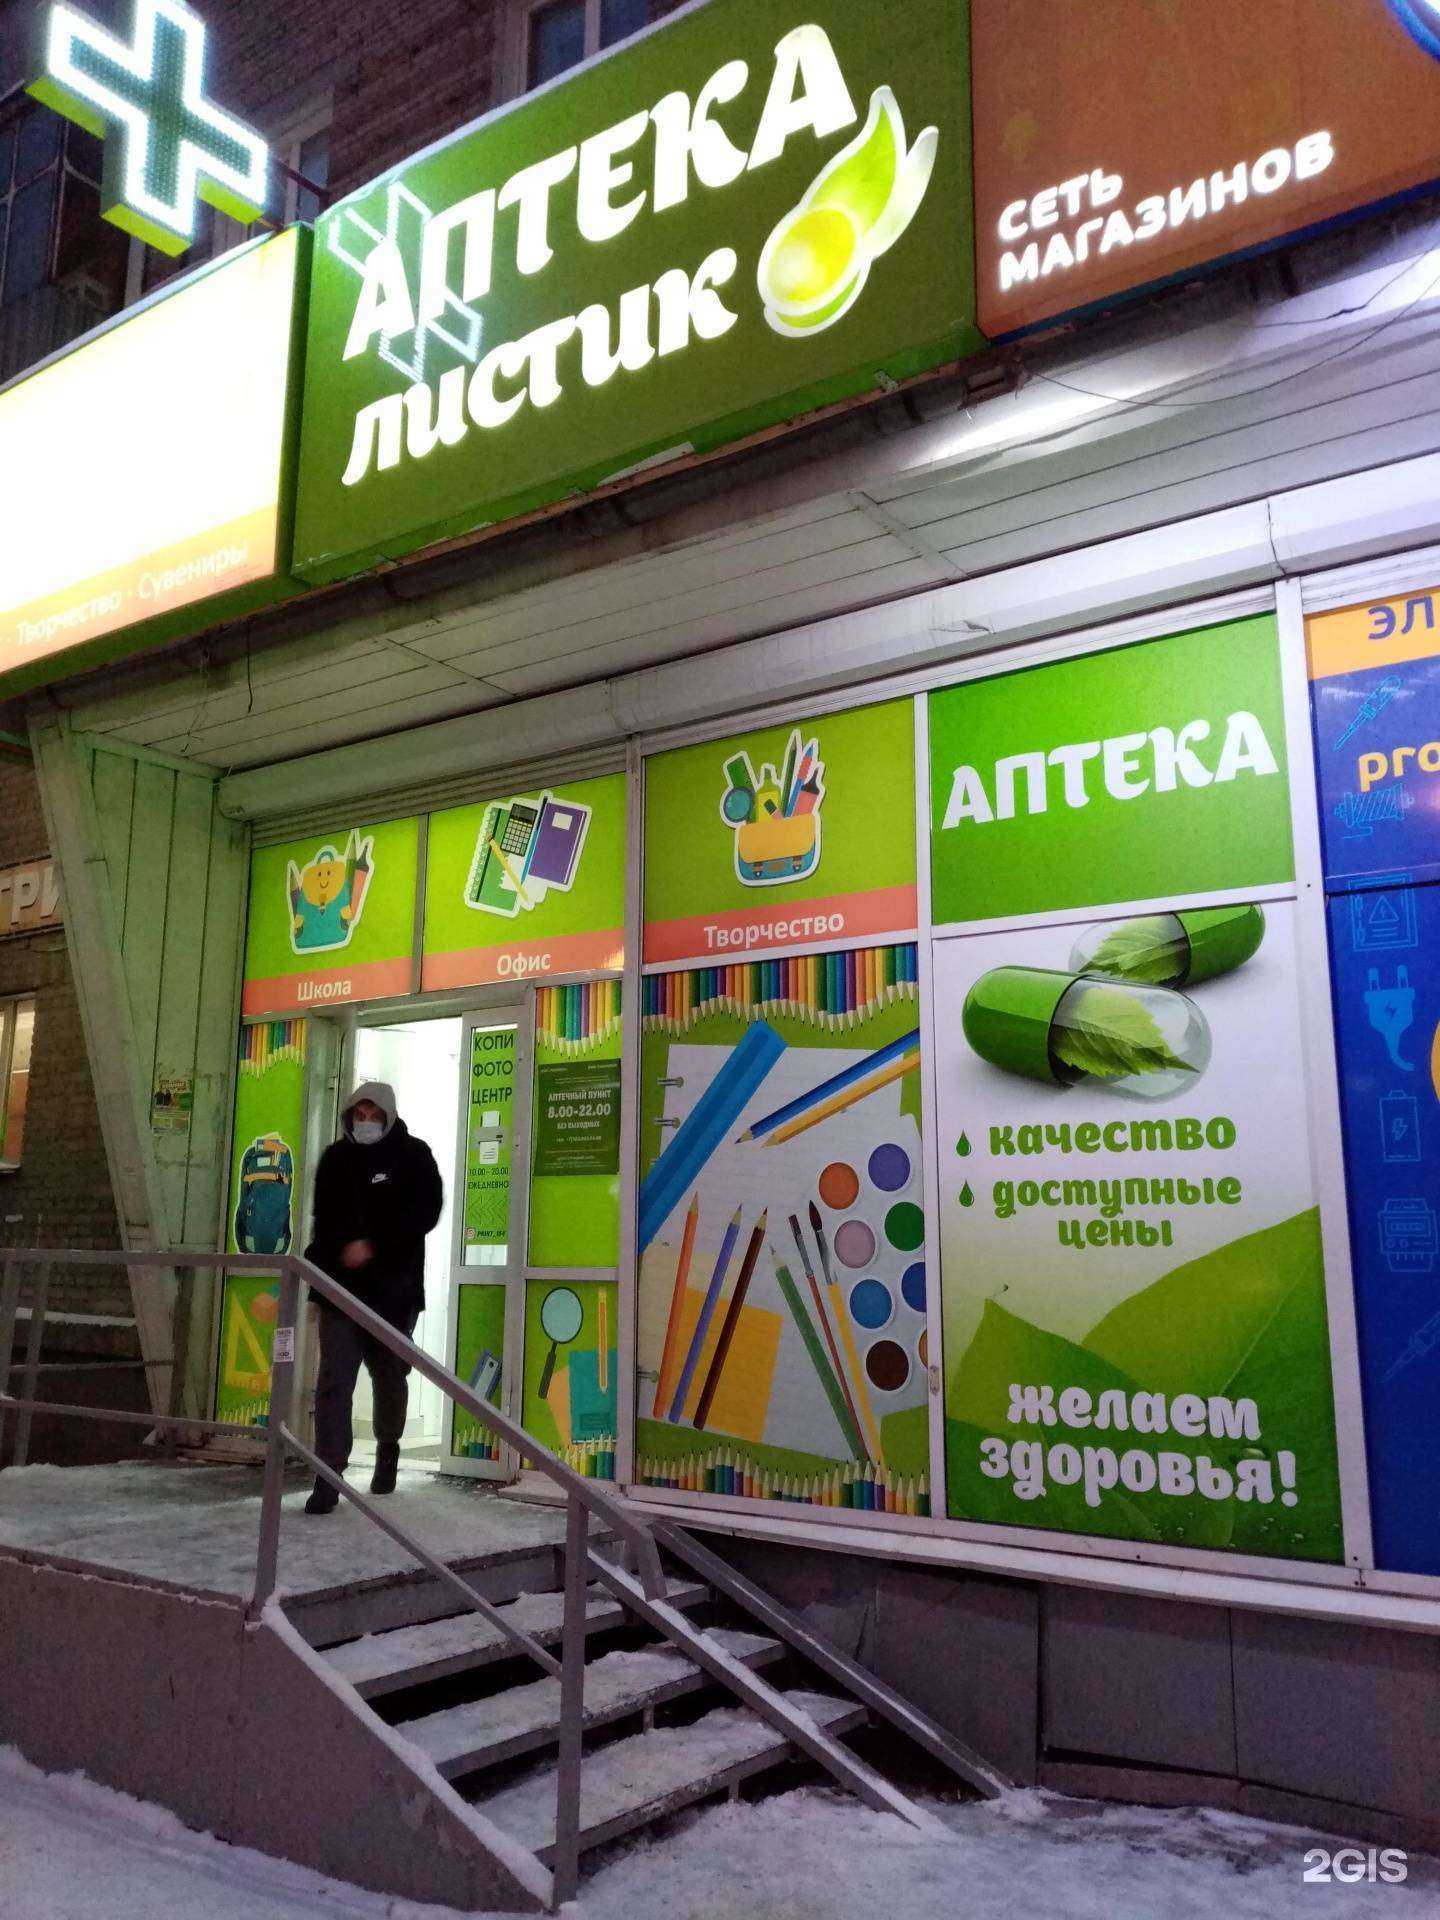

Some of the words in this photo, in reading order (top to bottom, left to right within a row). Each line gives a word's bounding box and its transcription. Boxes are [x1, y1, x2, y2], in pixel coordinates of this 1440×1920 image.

[343, 23, 858, 361] АПТЕКА
[998, 167, 1123, 242] СЕТЬ
[998, 131, 1336, 291] МАГАЗИНОВ
[341, 246, 739, 486] листик
[139, 540, 249, 602] Сувениры
[1367, 596, 1435, 640] ЭЛ
[942, 710, 1279, 830] АПТЕКА
[0, 866, 60, 926] РИ
[703, 912, 846, 951] Творчество
[496, 952, 551, 978] Офис
[297, 978, 352, 1003] Школа
[474, 1034, 514, 1051] КОПИ
[473, 1061, 513, 1077] ФОТО
[472, 1087, 512, 1106] ЦЕНТР
[548, 1090, 587, 1102] АПТЕЧНЫЙ
[588, 1089, 612, 1099] ПУНКТ
[548, 1103, 611, 1118] 8.00-22.00
[990, 1116, 1237, 1157] качество
[468, 1181, 509, 1190] ЕЖЕДНЕВНО
[993, 1175, 1243, 1219] доступные
[1058, 1217, 1174, 1248] цены
[1007, 1383, 1262, 1441] желаем
[979, 1436, 1299, 1509] здоровья!
